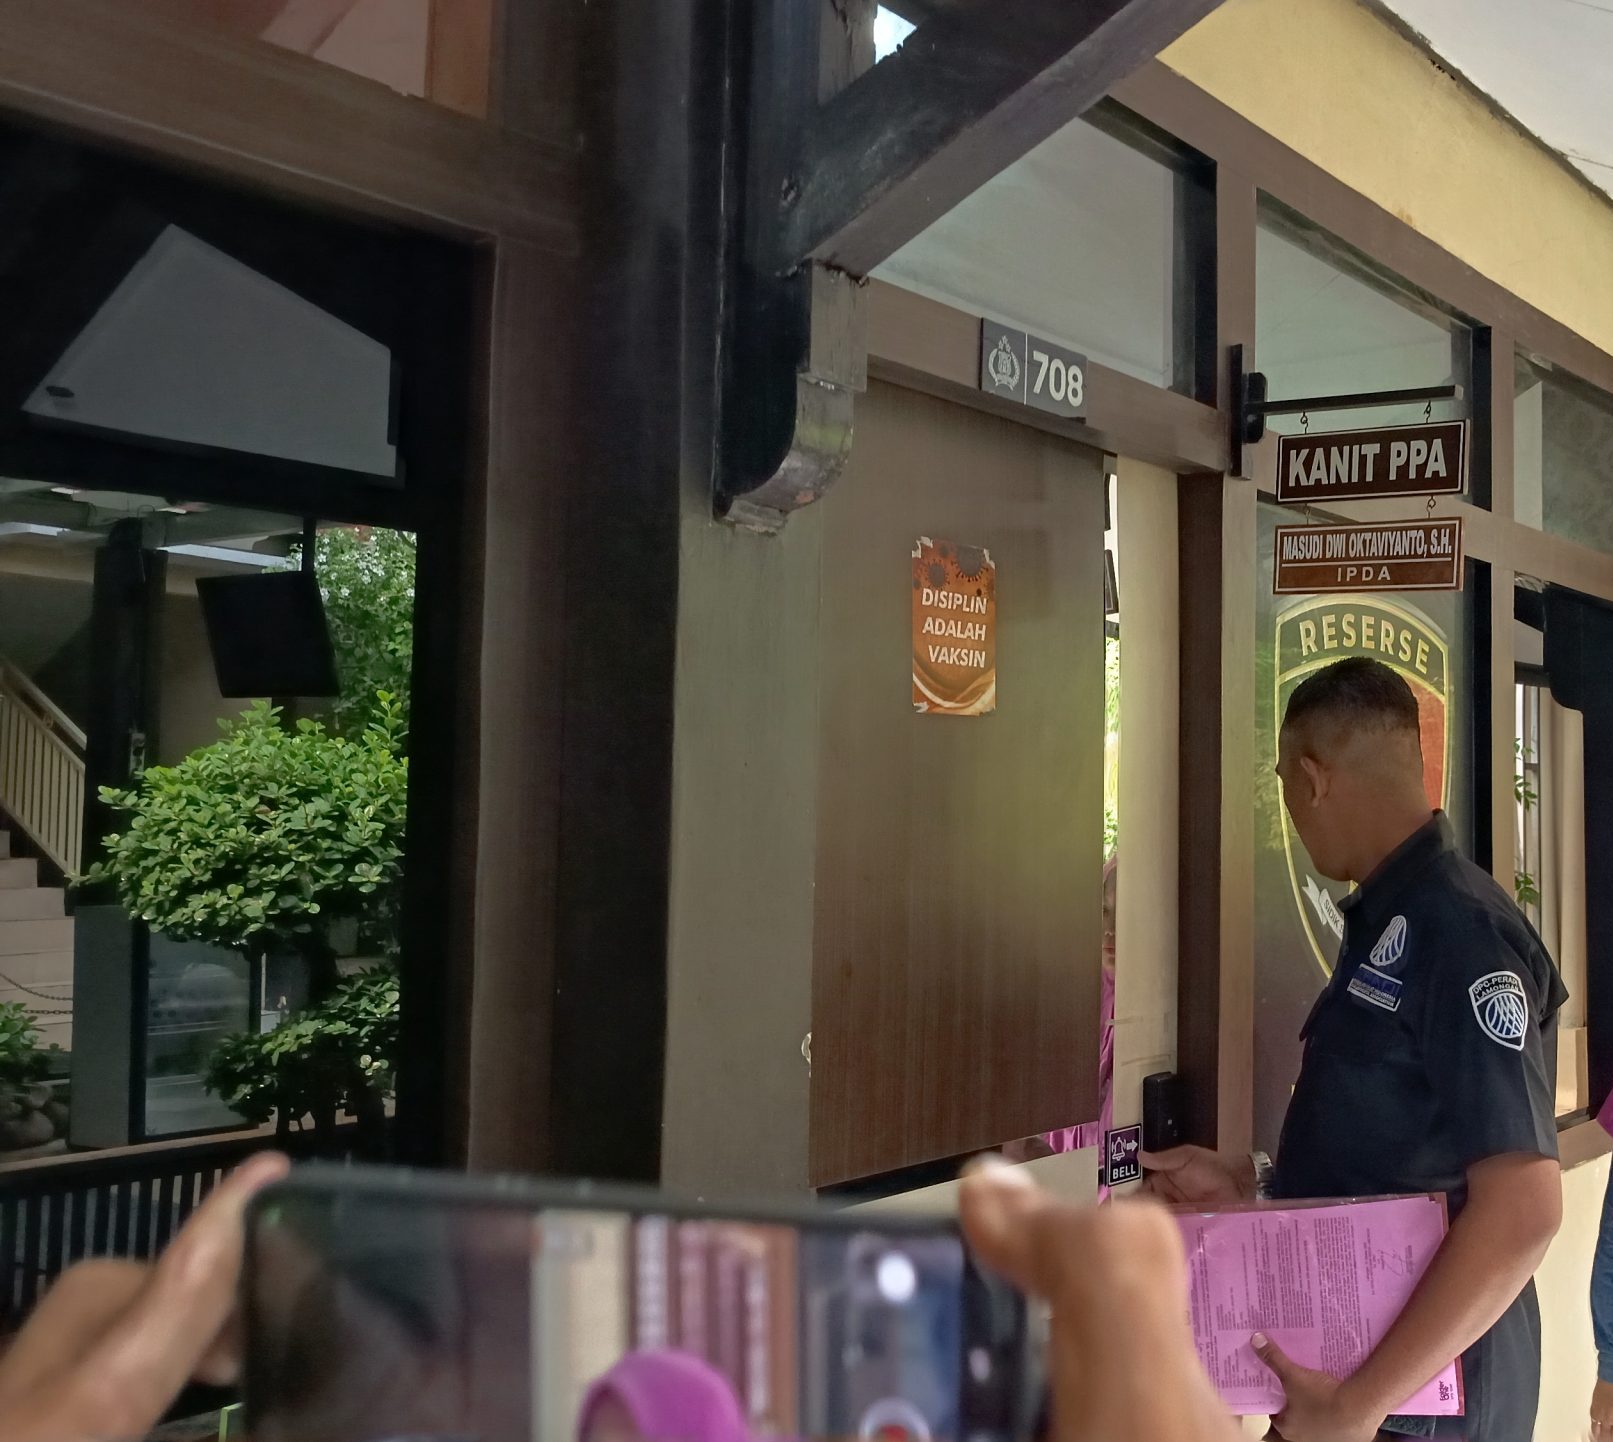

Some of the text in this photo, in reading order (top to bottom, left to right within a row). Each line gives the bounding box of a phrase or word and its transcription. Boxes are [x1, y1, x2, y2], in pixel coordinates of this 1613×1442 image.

[1033, 350, 1083, 407] 708
[1288, 438, 1447, 487] KANIT PPA
[1283, 528, 1452, 560] MASUDI DWI OKTAVIYANTO, S.H.
[1337, 565, 1391, 582] IPDA
[921, 587, 987, 615] DISIPLIN
[922, 616, 987, 641] ADALAH
[928, 644, 986, 669] VAKSIN
[1299, 613, 1430, 675] RESERSE
[1323, 899, 1340, 928] SIDIK
[1112, 1163, 1136, 1180] BELL
